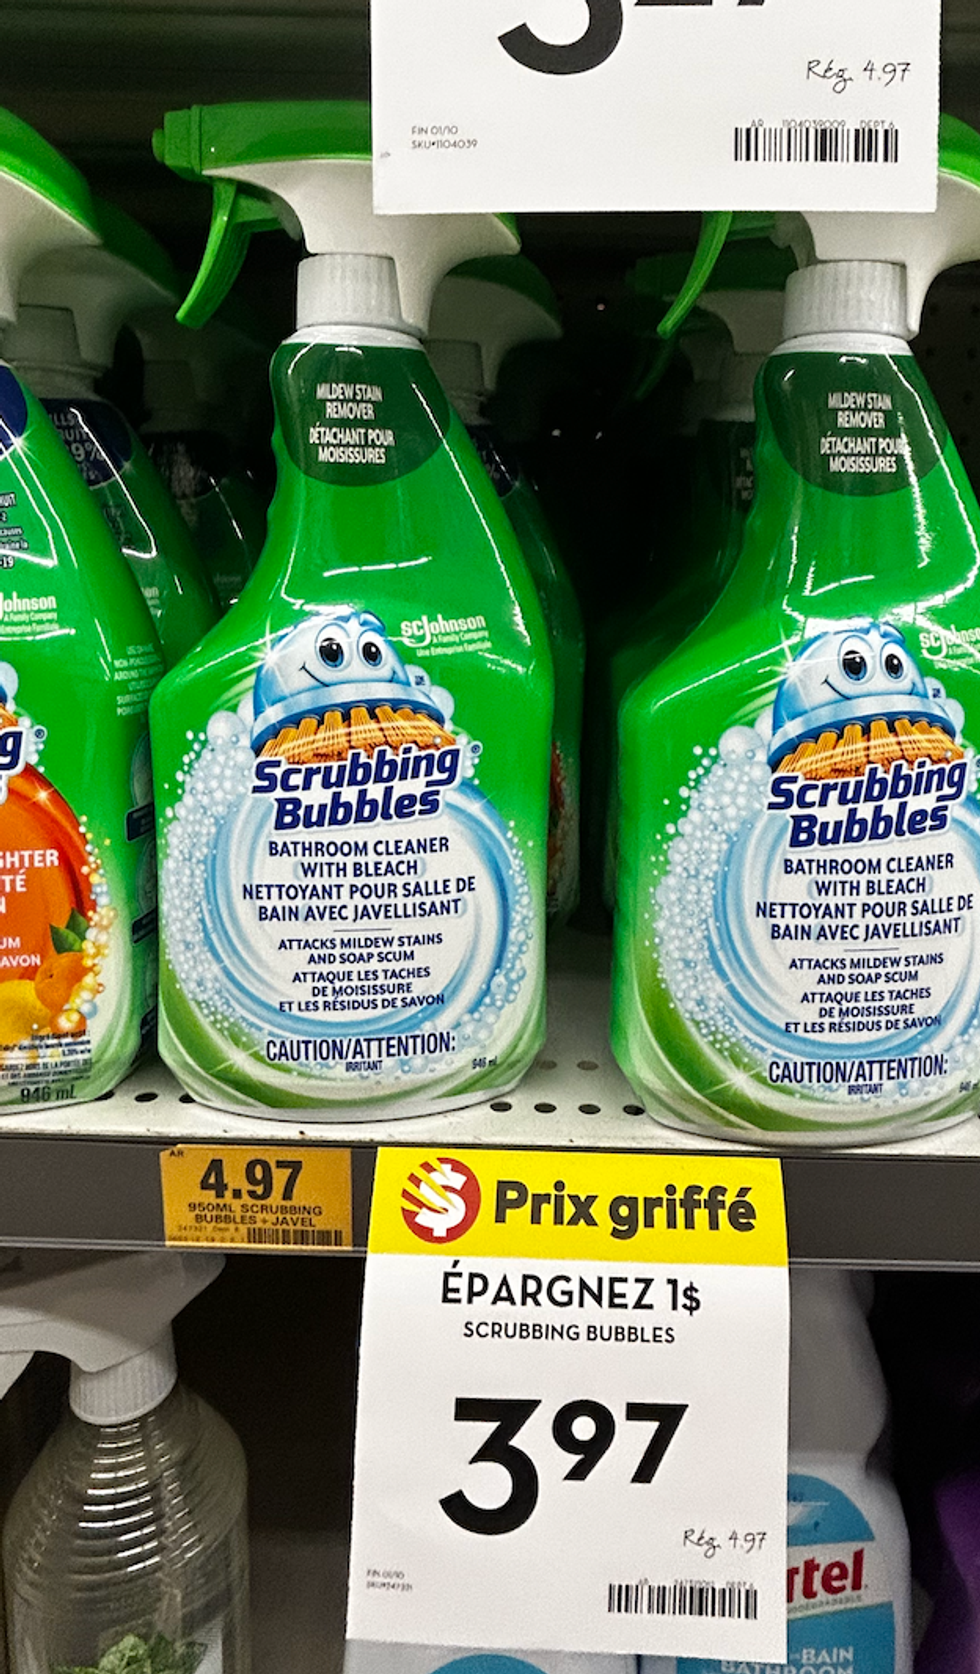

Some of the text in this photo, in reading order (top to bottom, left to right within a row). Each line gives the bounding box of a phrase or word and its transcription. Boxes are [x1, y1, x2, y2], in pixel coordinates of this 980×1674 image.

[862, 59, 911, 87] 4.97
[411, 125, 459, 136] FIN 01/10
[316, 383, 383, 401] MILDEW STAIN
[828, 392, 892, 409] MILDEW STAIN
[325, 401, 375, 420] REMOVER
[837, 411, 885, 429] REMOVER
[309, 422, 396, 446] DÉTACHANT POUR
[820, 431, 877, 454] DÉTACHANT
[318, 447, 386, 464] MOISISSURES
[829, 456, 897, 473] MOISISSURES
[460, 630, 489, 641] Company
[251, 746, 460, 794] Scrubbing
[767, 759, 967, 811] Scrubbing
[274, 785, 440, 831] Bubbles
[789, 801, 948, 848] Bubbles
[268, 837, 450, 857] BATHROOM CLEANER
[301, 860, 418, 878] WITH BLEACH
[783, 853, 954, 875] BATHROOM CLEANER
[242, 876, 476, 901] NETTOYANT POUR SALLE DE
[815, 877, 926, 897] WITH BLEACH
[258, 898, 462, 923] BAIN AVEC JAVELLISANT
[755, 894, 974, 919] NETTOYANT POUR SALLE DE
[770, 917, 961, 942] BAIN AVEC JAVELLISANT
[278, 933, 443, 951] ATTACKS MILDEW STAINS
[307, 950, 415, 964] AND SOAP SCUM
[788, 953, 944, 971] ATTACKS MILDEW STAINS
[292, 967, 431, 987] ATTAQUE LES TACHES
[817, 970, 919, 985] AND SOAP SCUM
[312, 982, 413, 997] DE MOISISSURE
[800, 987, 931, 1005] ATTAQUE LES TACHES
[279, 993, 445, 1013] ET LES RÉSIDUS DE SAVON
[819, 1003, 915, 1018] DE MOISISSURE
[785, 1015, 942, 1033] ET LES RÉSIDUS DE SAVON
[266, 1031, 456, 1062] CAUTION/ATTENTION:
[345, 1059, 384, 1072] IRRITANT
[472, 1057, 486, 1070] 946
[768, 1054, 948, 1084] CAUTION/ATTENTION:
[21, 1085, 51, 1104] 946
[848, 1083, 883, 1095] IRRITANT
[200, 1158, 303, 1201] 4.97
[188, 1202, 323, 1217] 950ML SCRUBBING
[495, 1179, 756, 1240] Prix griffé
[195, 1213, 257, 1225] BUBBLES
[271, 1216, 316, 1228] JAVEL
[441, 1260, 701, 1316] ÉPARGNEZ 1$
[463, 1321, 675, 1344] SCRUBBING BUBBLES
[728, 1530, 767, 1553] 4.97
